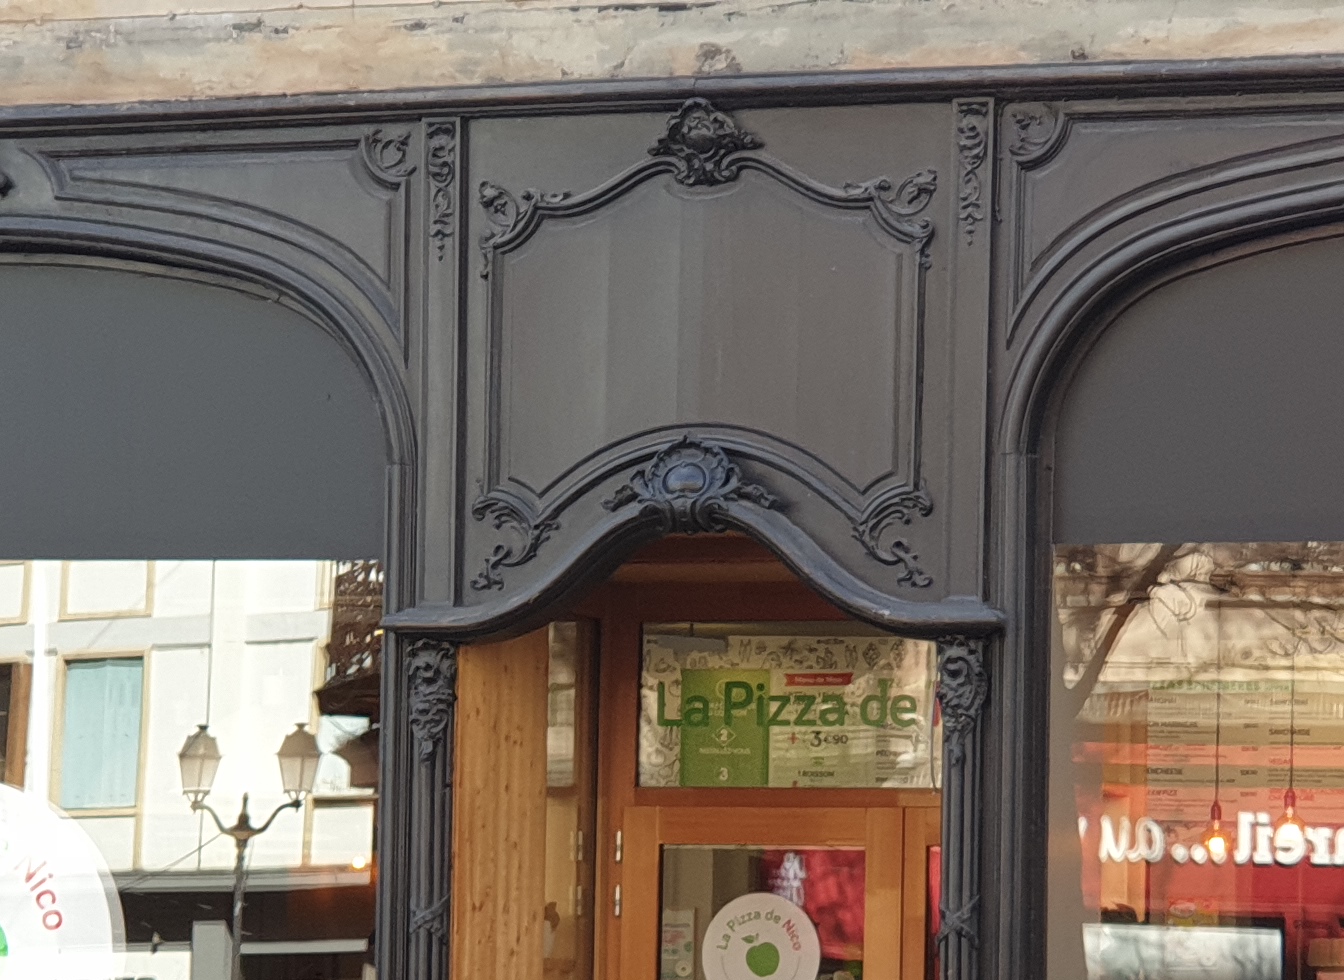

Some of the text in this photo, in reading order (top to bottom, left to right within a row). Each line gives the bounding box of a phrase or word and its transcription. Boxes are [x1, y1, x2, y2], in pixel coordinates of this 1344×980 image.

[657, 678, 917, 727] La Pizza de
[14, 855, 63, 931] Nico
[716, 909, 802, 951] La Pizza de Nico
